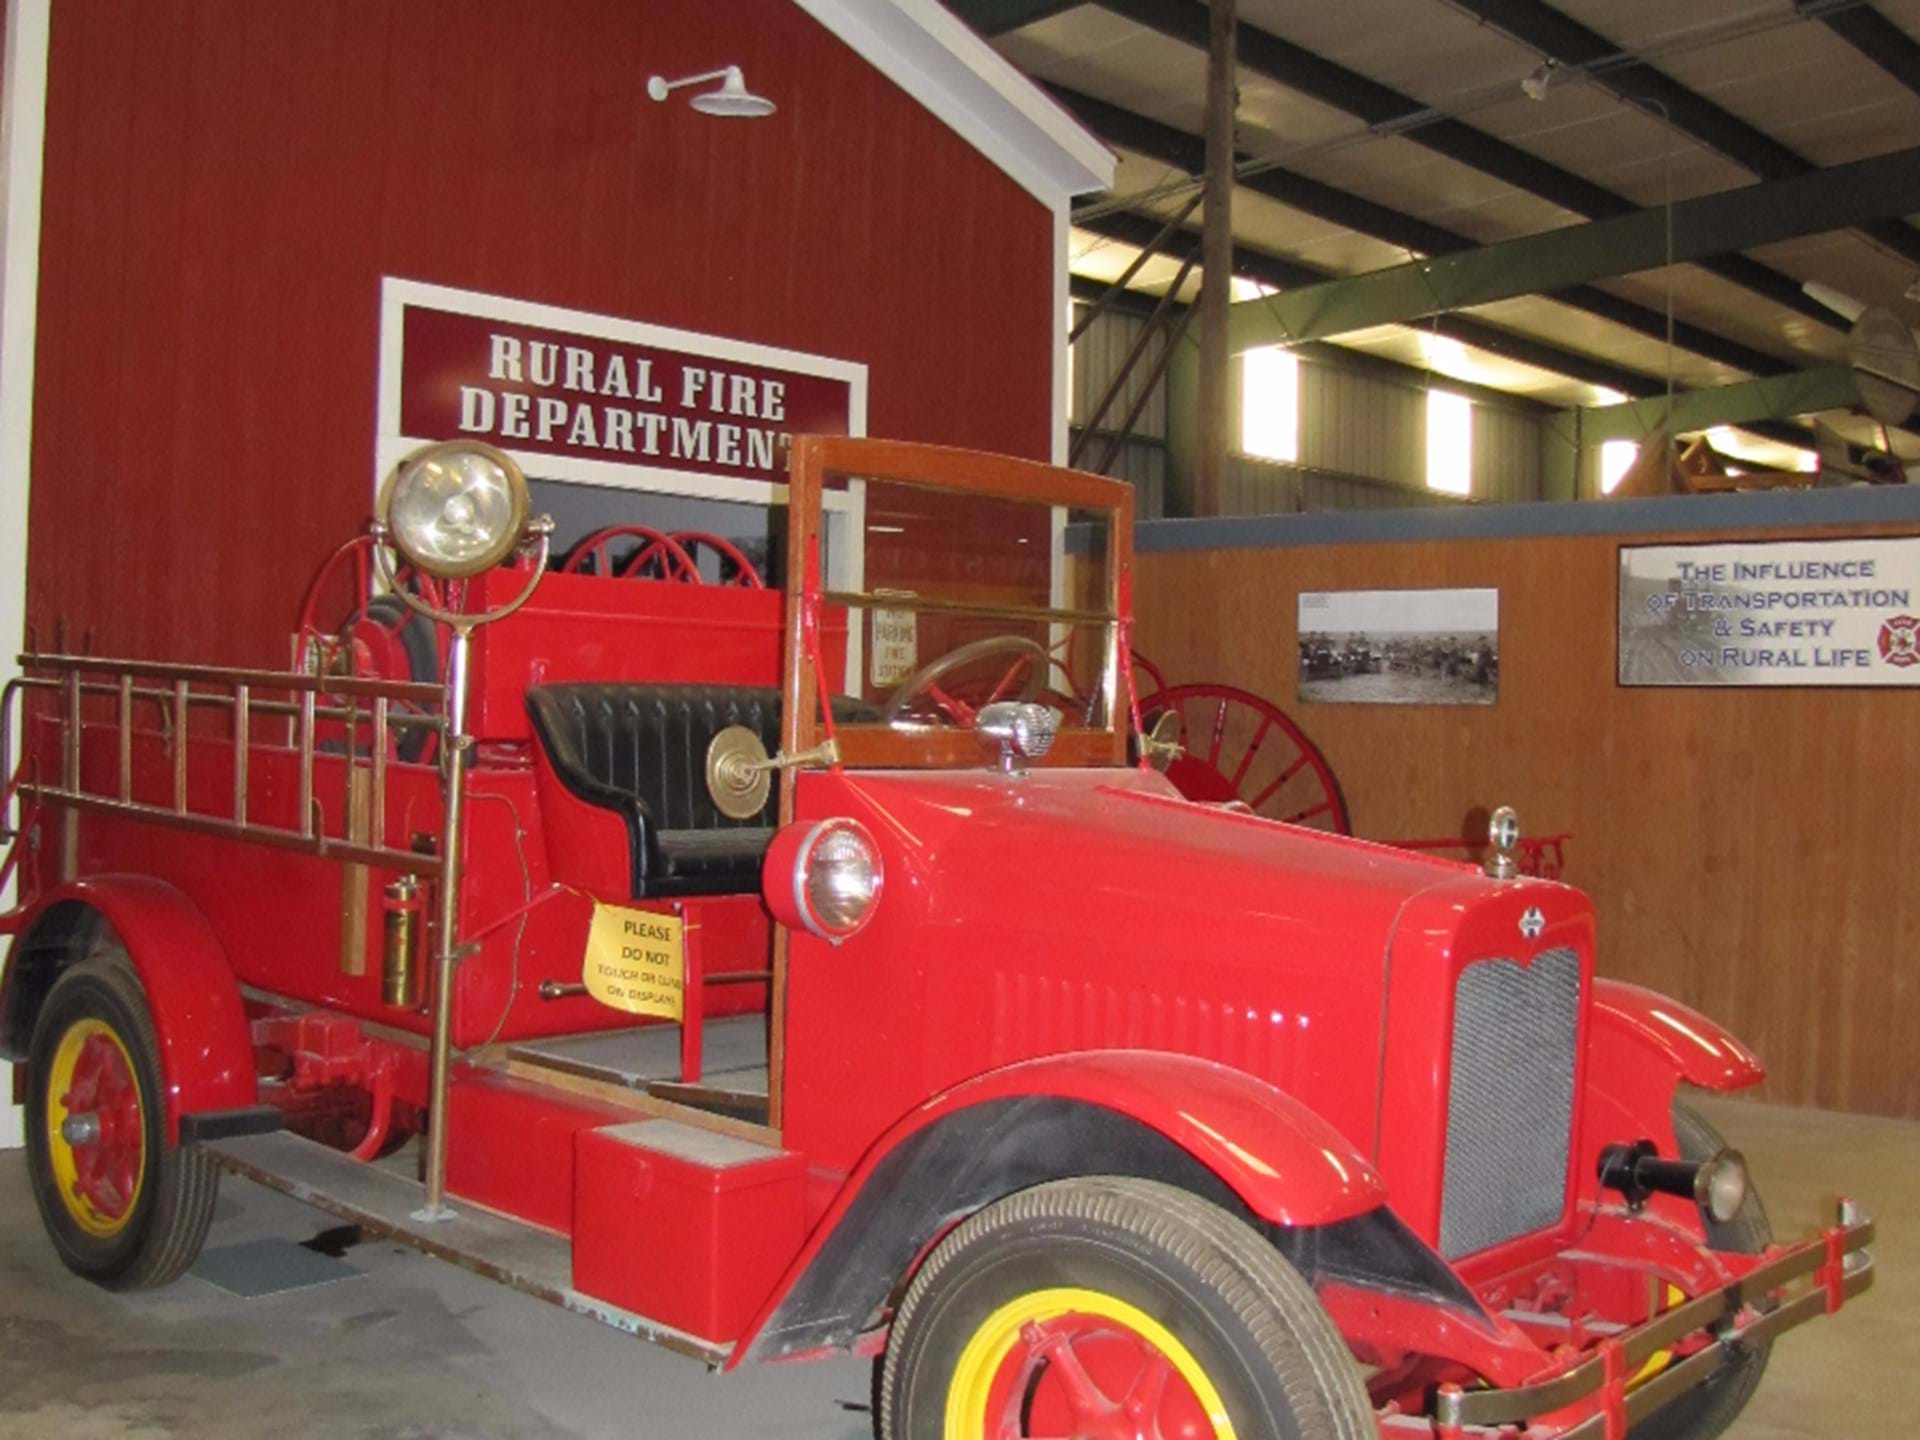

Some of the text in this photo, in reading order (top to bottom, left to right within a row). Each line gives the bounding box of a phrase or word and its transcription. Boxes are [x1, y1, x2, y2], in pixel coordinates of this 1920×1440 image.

[488, 334, 785, 422] RURAL FIRE
[459, 385, 794, 473] DEPARTMENT
[1677, 560, 1875, 582] THE INFLUENCE
[1647, 590, 1910, 611] OF TRANSPORTATION
[1714, 619, 1835, 637] & SAFETY
[1681, 648, 1871, 667] ON RURAL LIFE
[624, 920, 672, 941] PLEASE
[622, 946, 671, 967] DO NOT
[597, 963, 638, 980] TOUCH
